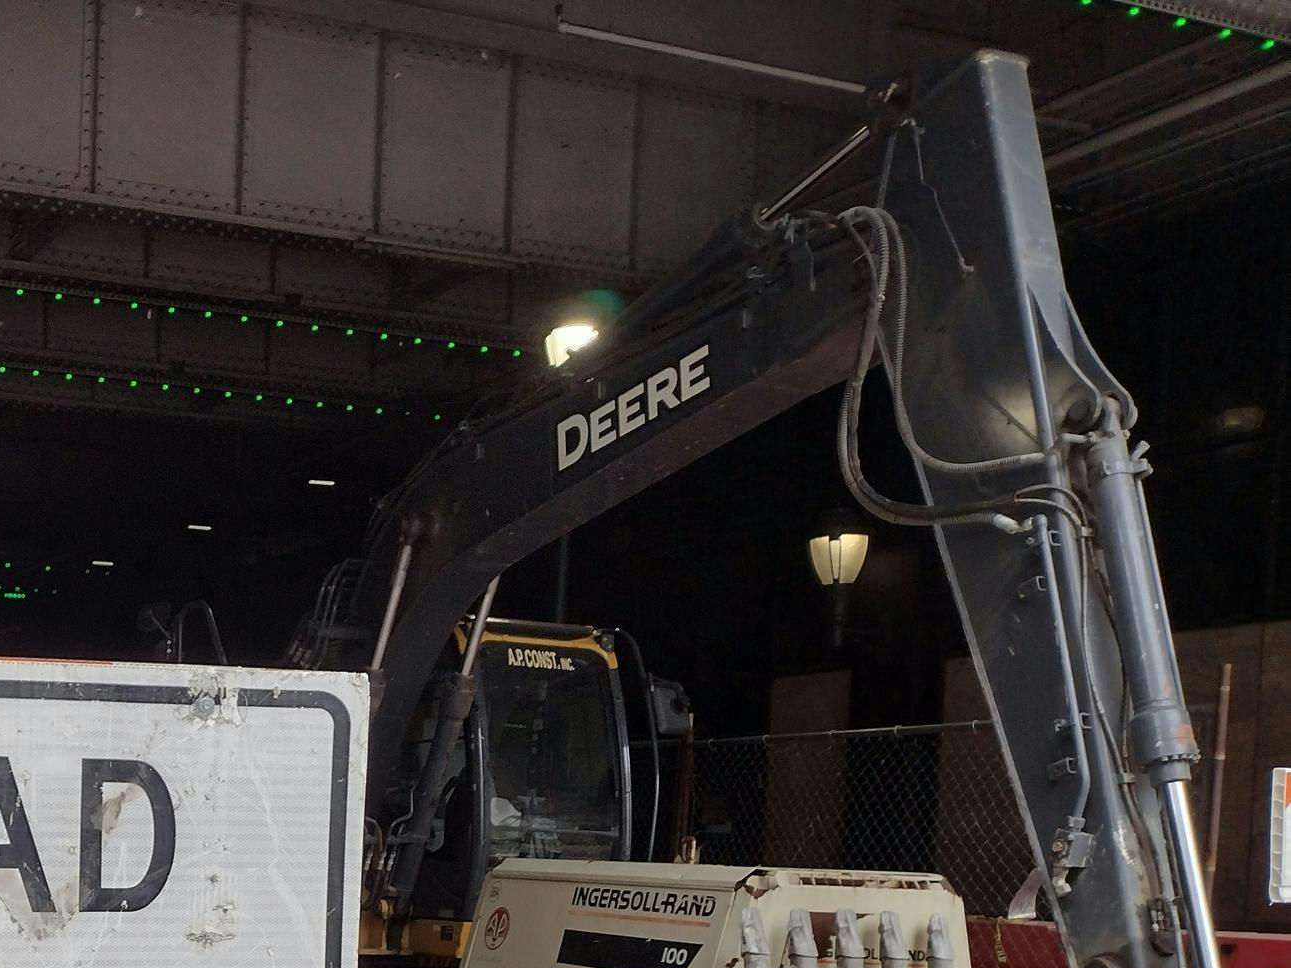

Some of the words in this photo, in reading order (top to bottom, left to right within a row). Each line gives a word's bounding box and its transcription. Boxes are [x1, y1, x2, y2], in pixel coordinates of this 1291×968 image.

[557, 344, 711, 472] DEERE
[572, 886, 717, 917] INGERSOLL-RAND
[661, 947, 688, 966] 100
